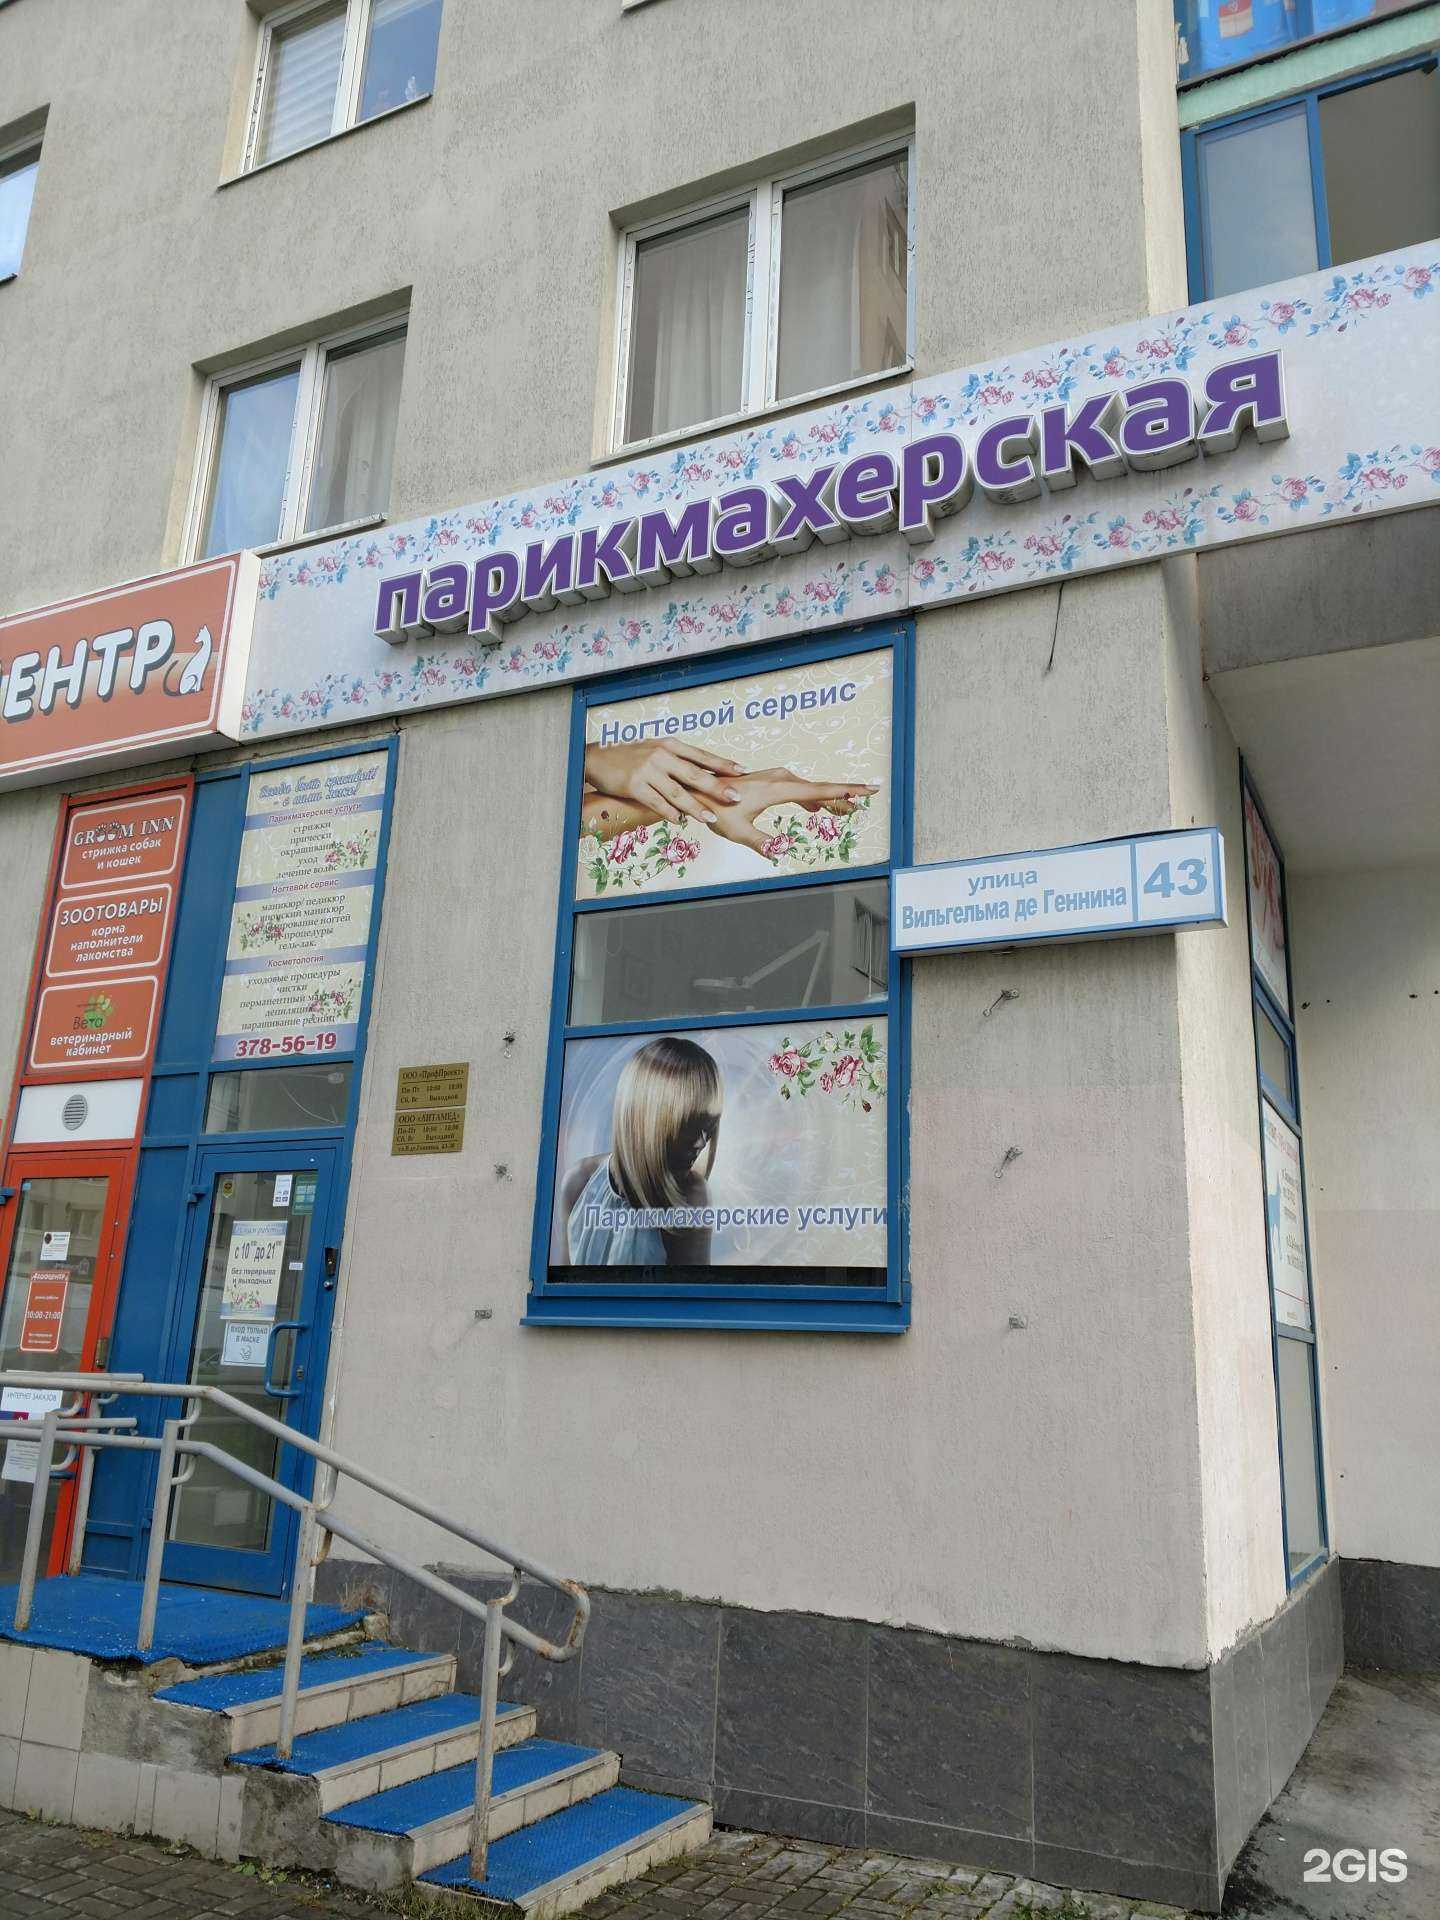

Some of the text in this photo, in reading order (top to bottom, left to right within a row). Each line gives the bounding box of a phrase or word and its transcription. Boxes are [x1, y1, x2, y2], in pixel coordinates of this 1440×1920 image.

[374, 352, 1284, 634] парикмахерская
[0, 618, 175, 722] ЕНТР
[600, 682, 857, 746] Ногтевой сервис
[269, 803, 362, 823] Парикмахерские услуги
[141, 817, 174, 835] INN
[293, 822, 331, 834] стрижки
[290, 832, 332, 845] прически
[81, 837, 161, 860] стрижка собак
[97, 855, 142, 870] и кошек
[297, 857, 318, 868] уход
[272, 879, 339, 894] Ногтевой сервис
[968, 868, 1038, 896] улица
[1143, 858, 1208, 899] 43
[61, 897, 163, 926] ЗООТОВАРЫ
[303, 904, 345, 917] маникюр
[902, 886, 1127, 929] Вильгельма де Геннина
[320, 913, 351, 926] ногтей
[91, 923, 126, 938] корма
[70, 935, 144, 952] наполнители
[76, 947, 133, 963] лакомства
[267, 955, 324, 967] Косметология
[247, 969, 341, 988] уходовые процедуры
[276, 984, 308, 993] чистки
[240, 994, 306, 1009] перманентный
[50, 1027, 133, 1047] ветеринарный
[236, 1032, 337, 1057] 378-56-19
[66, 1044, 111, 1057] кабинет
[402, 1071, 417, 1080] ООО
[398, 1115, 416, 1124] ООО
[584, 1204, 888, 1231] Парикмахерские услуги
[234, 1247, 239, 1259] с
[254, 1246, 265, 1262] до
